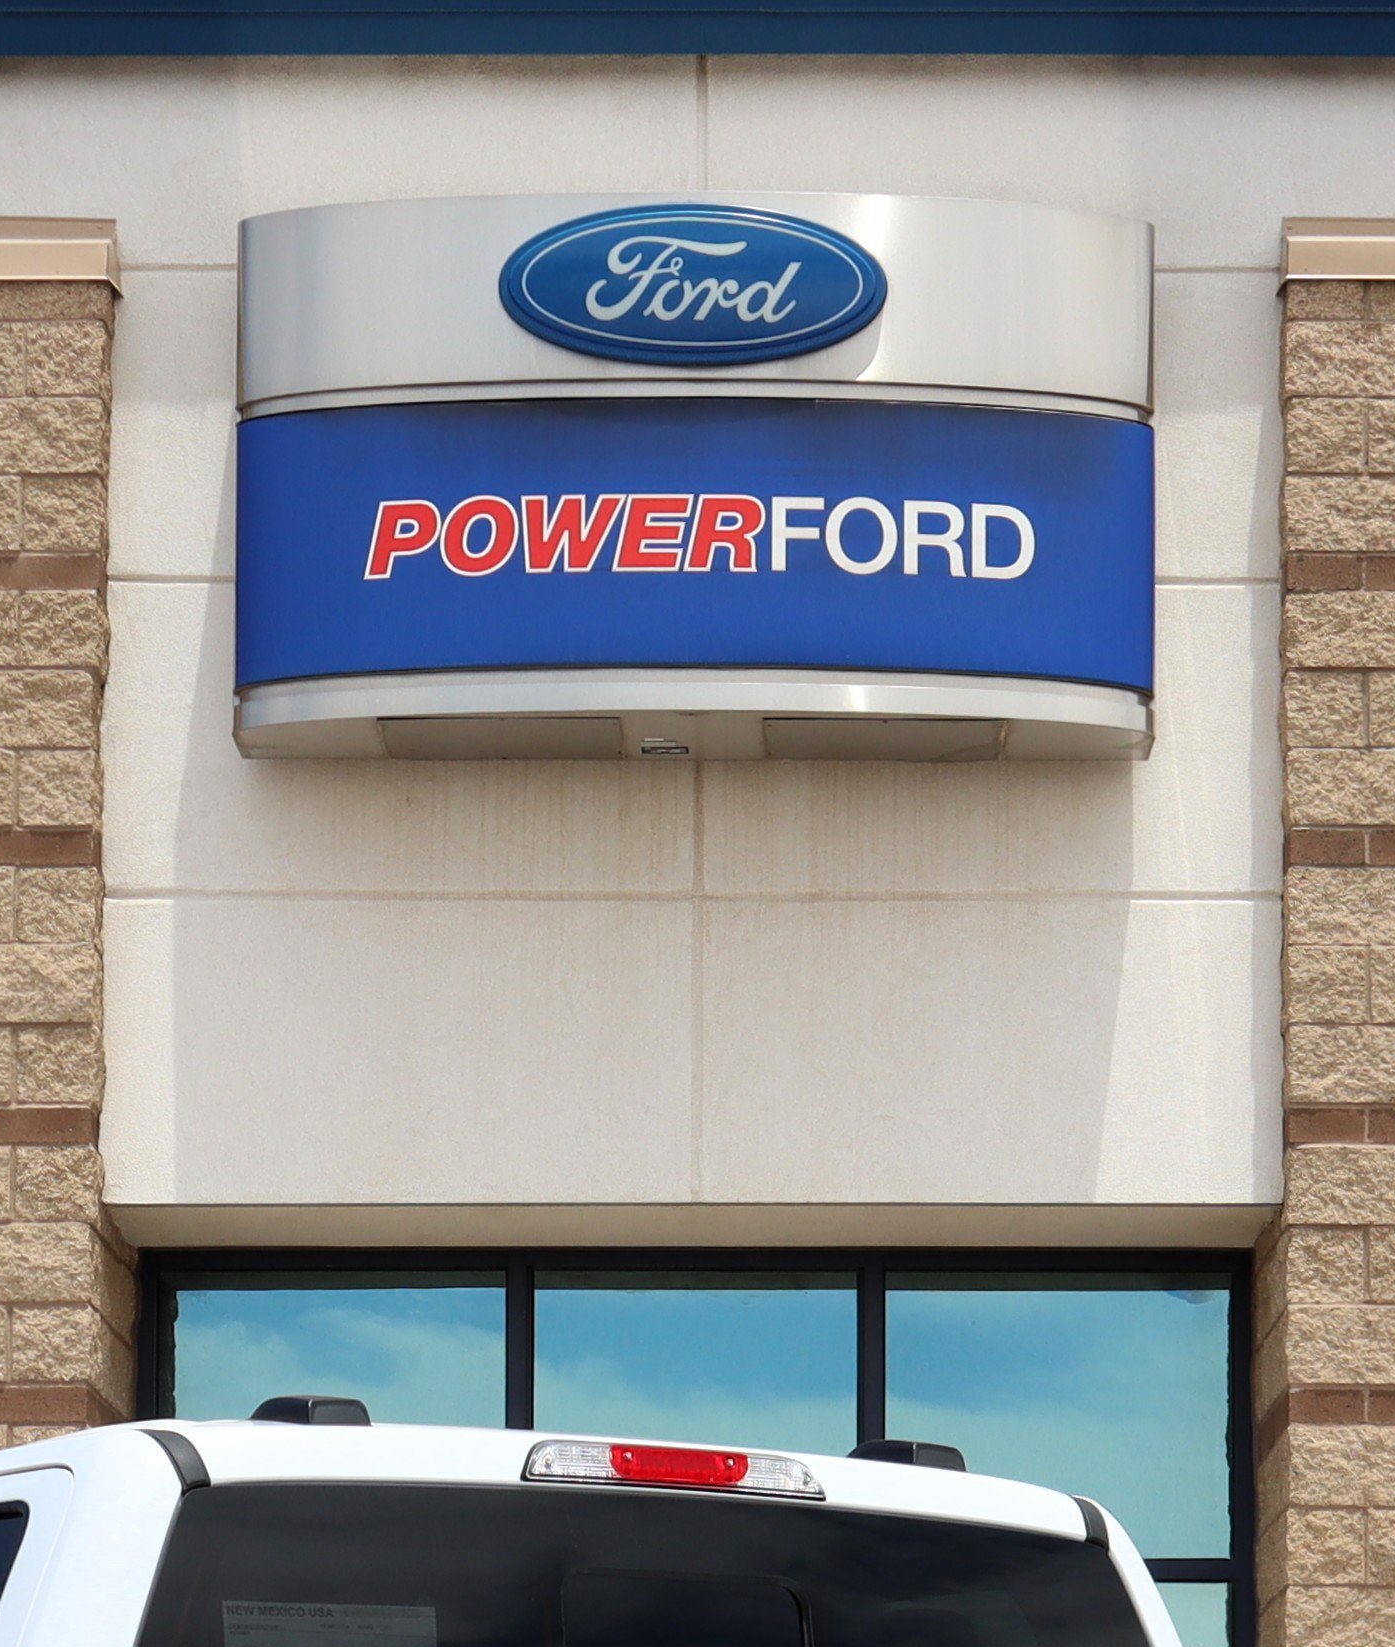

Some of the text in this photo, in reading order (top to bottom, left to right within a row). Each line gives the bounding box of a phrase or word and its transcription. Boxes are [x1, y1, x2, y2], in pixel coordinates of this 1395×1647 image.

[585, 234, 801, 324] Ford
[363, 493, 1037, 581] POWERFORD
[226, 1605, 256, 1616] NEW
[258, 1606, 306, 1618] MEXICO
[308, 1607, 335, 1618] USA
